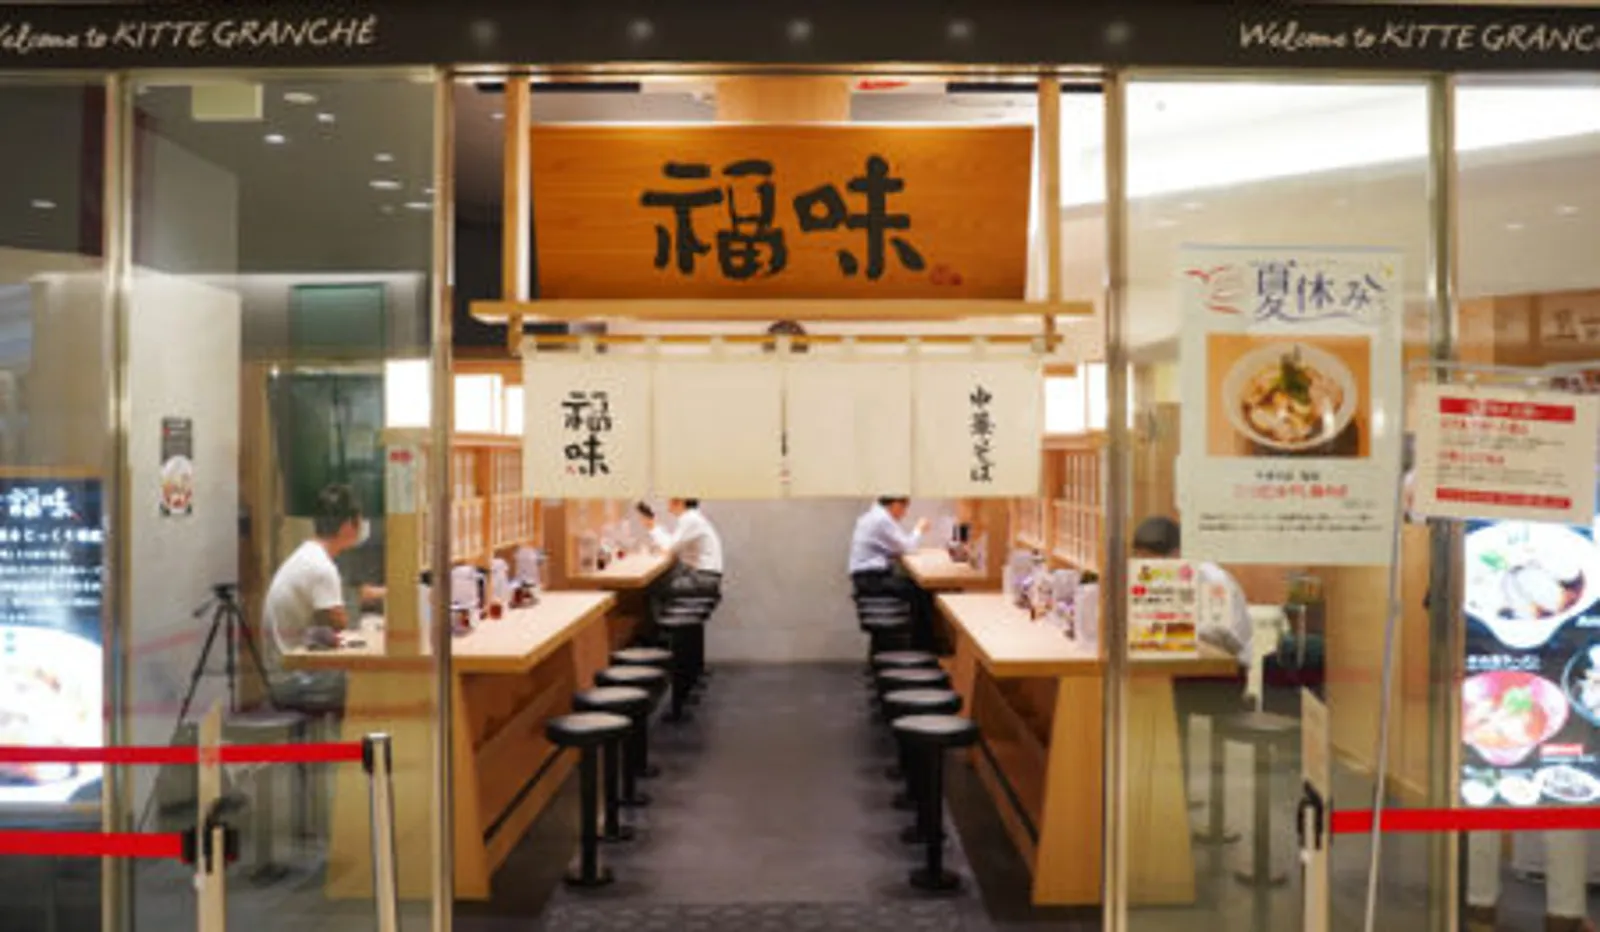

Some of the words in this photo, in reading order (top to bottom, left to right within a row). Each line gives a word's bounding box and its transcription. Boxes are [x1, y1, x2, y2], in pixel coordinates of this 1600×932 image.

[0, 22, 78, 54] elcome
[85, 28, 107, 48] to
[113, 20, 203, 48] KITTE
[211, 14, 378, 48] GRANCHÉ
[1239, 20, 1347, 50] Welcome
[1353, 26, 1376, 49] to
[1381, 23, 1476, 49] KITTE
[1481, 24, 1600, 51] GRANC
[640, 155, 925, 280] 福味
[1255, 258, 1388, 322] 夏休み
[561, 390, 612, 477] 福味
[969, 384, 995, 482] 中華そば
